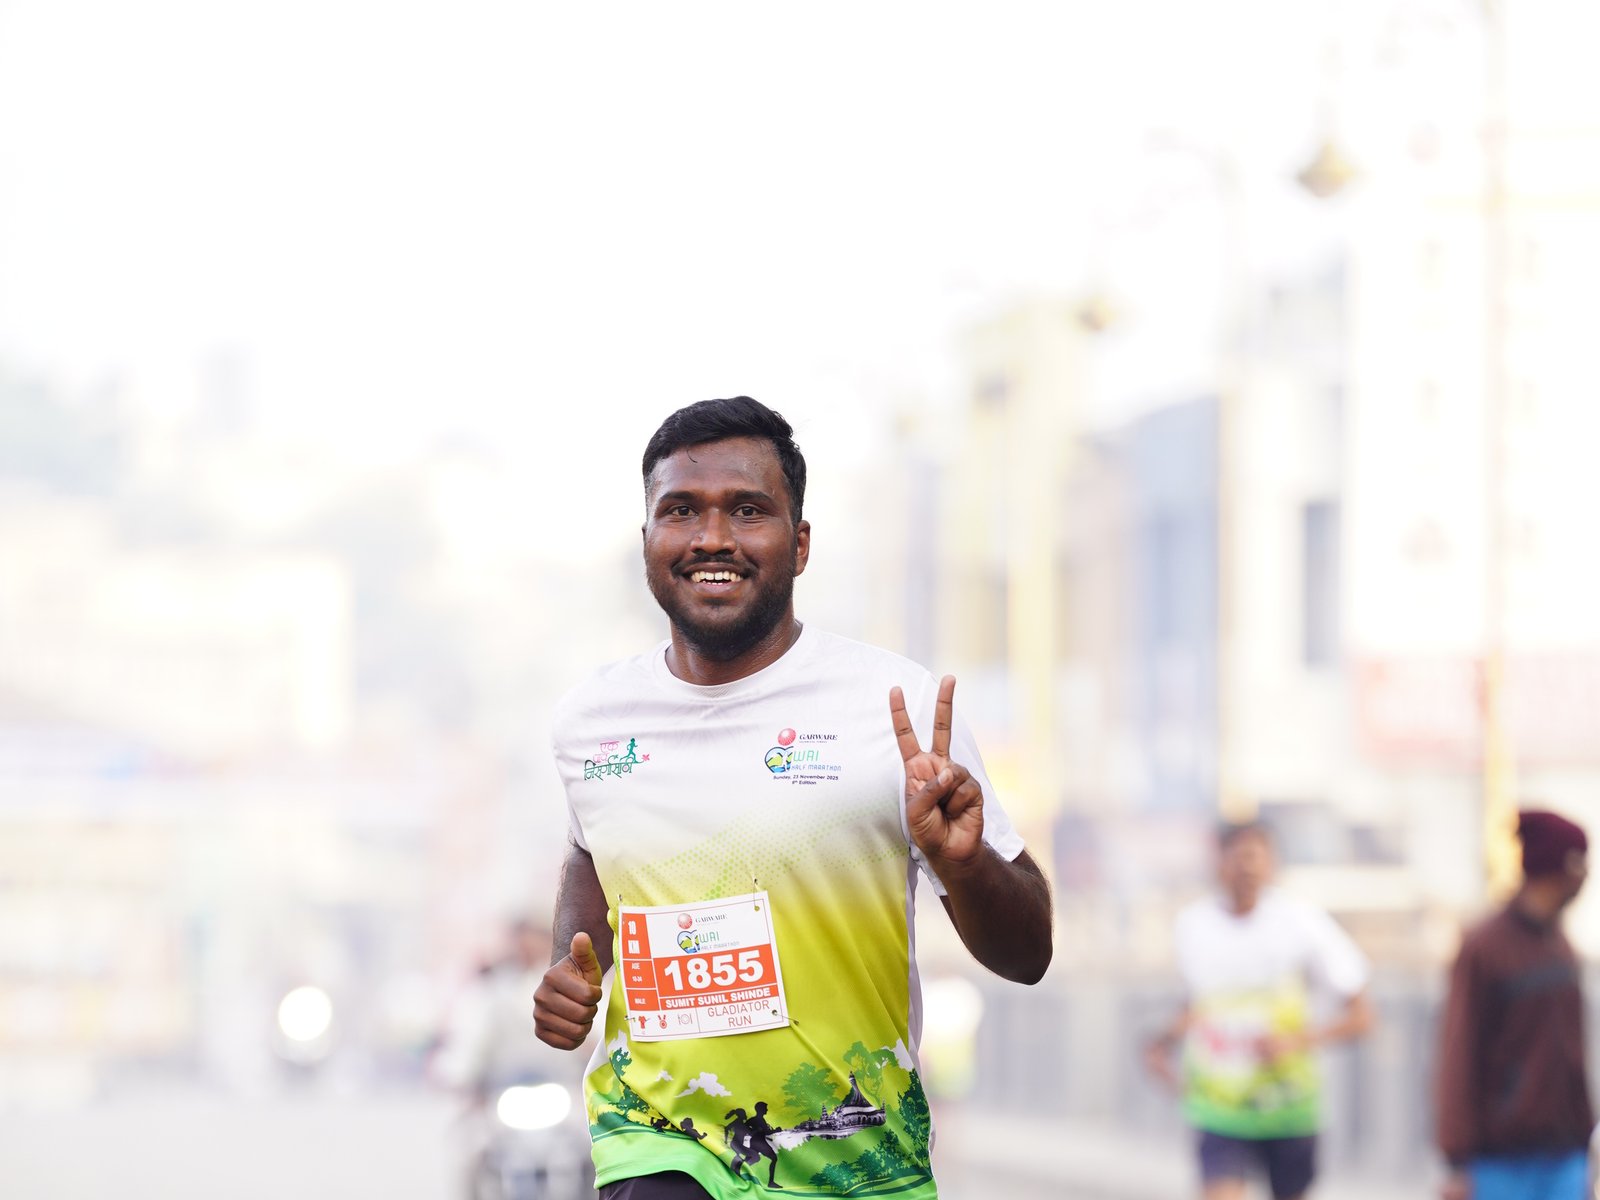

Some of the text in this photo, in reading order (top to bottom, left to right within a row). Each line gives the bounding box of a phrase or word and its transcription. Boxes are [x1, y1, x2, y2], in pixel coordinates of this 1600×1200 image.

[793, 750, 819, 761] WAI
[628, 920, 637, 935] 10
[699, 931, 720, 943] WAI
[664, 950, 764, 991] 1855
[666, 987, 771, 1009] SUMIT SUNIL SHINDE
[707, 999, 770, 1017] GLADIATOR
[728, 1015, 752, 1028] RUN
